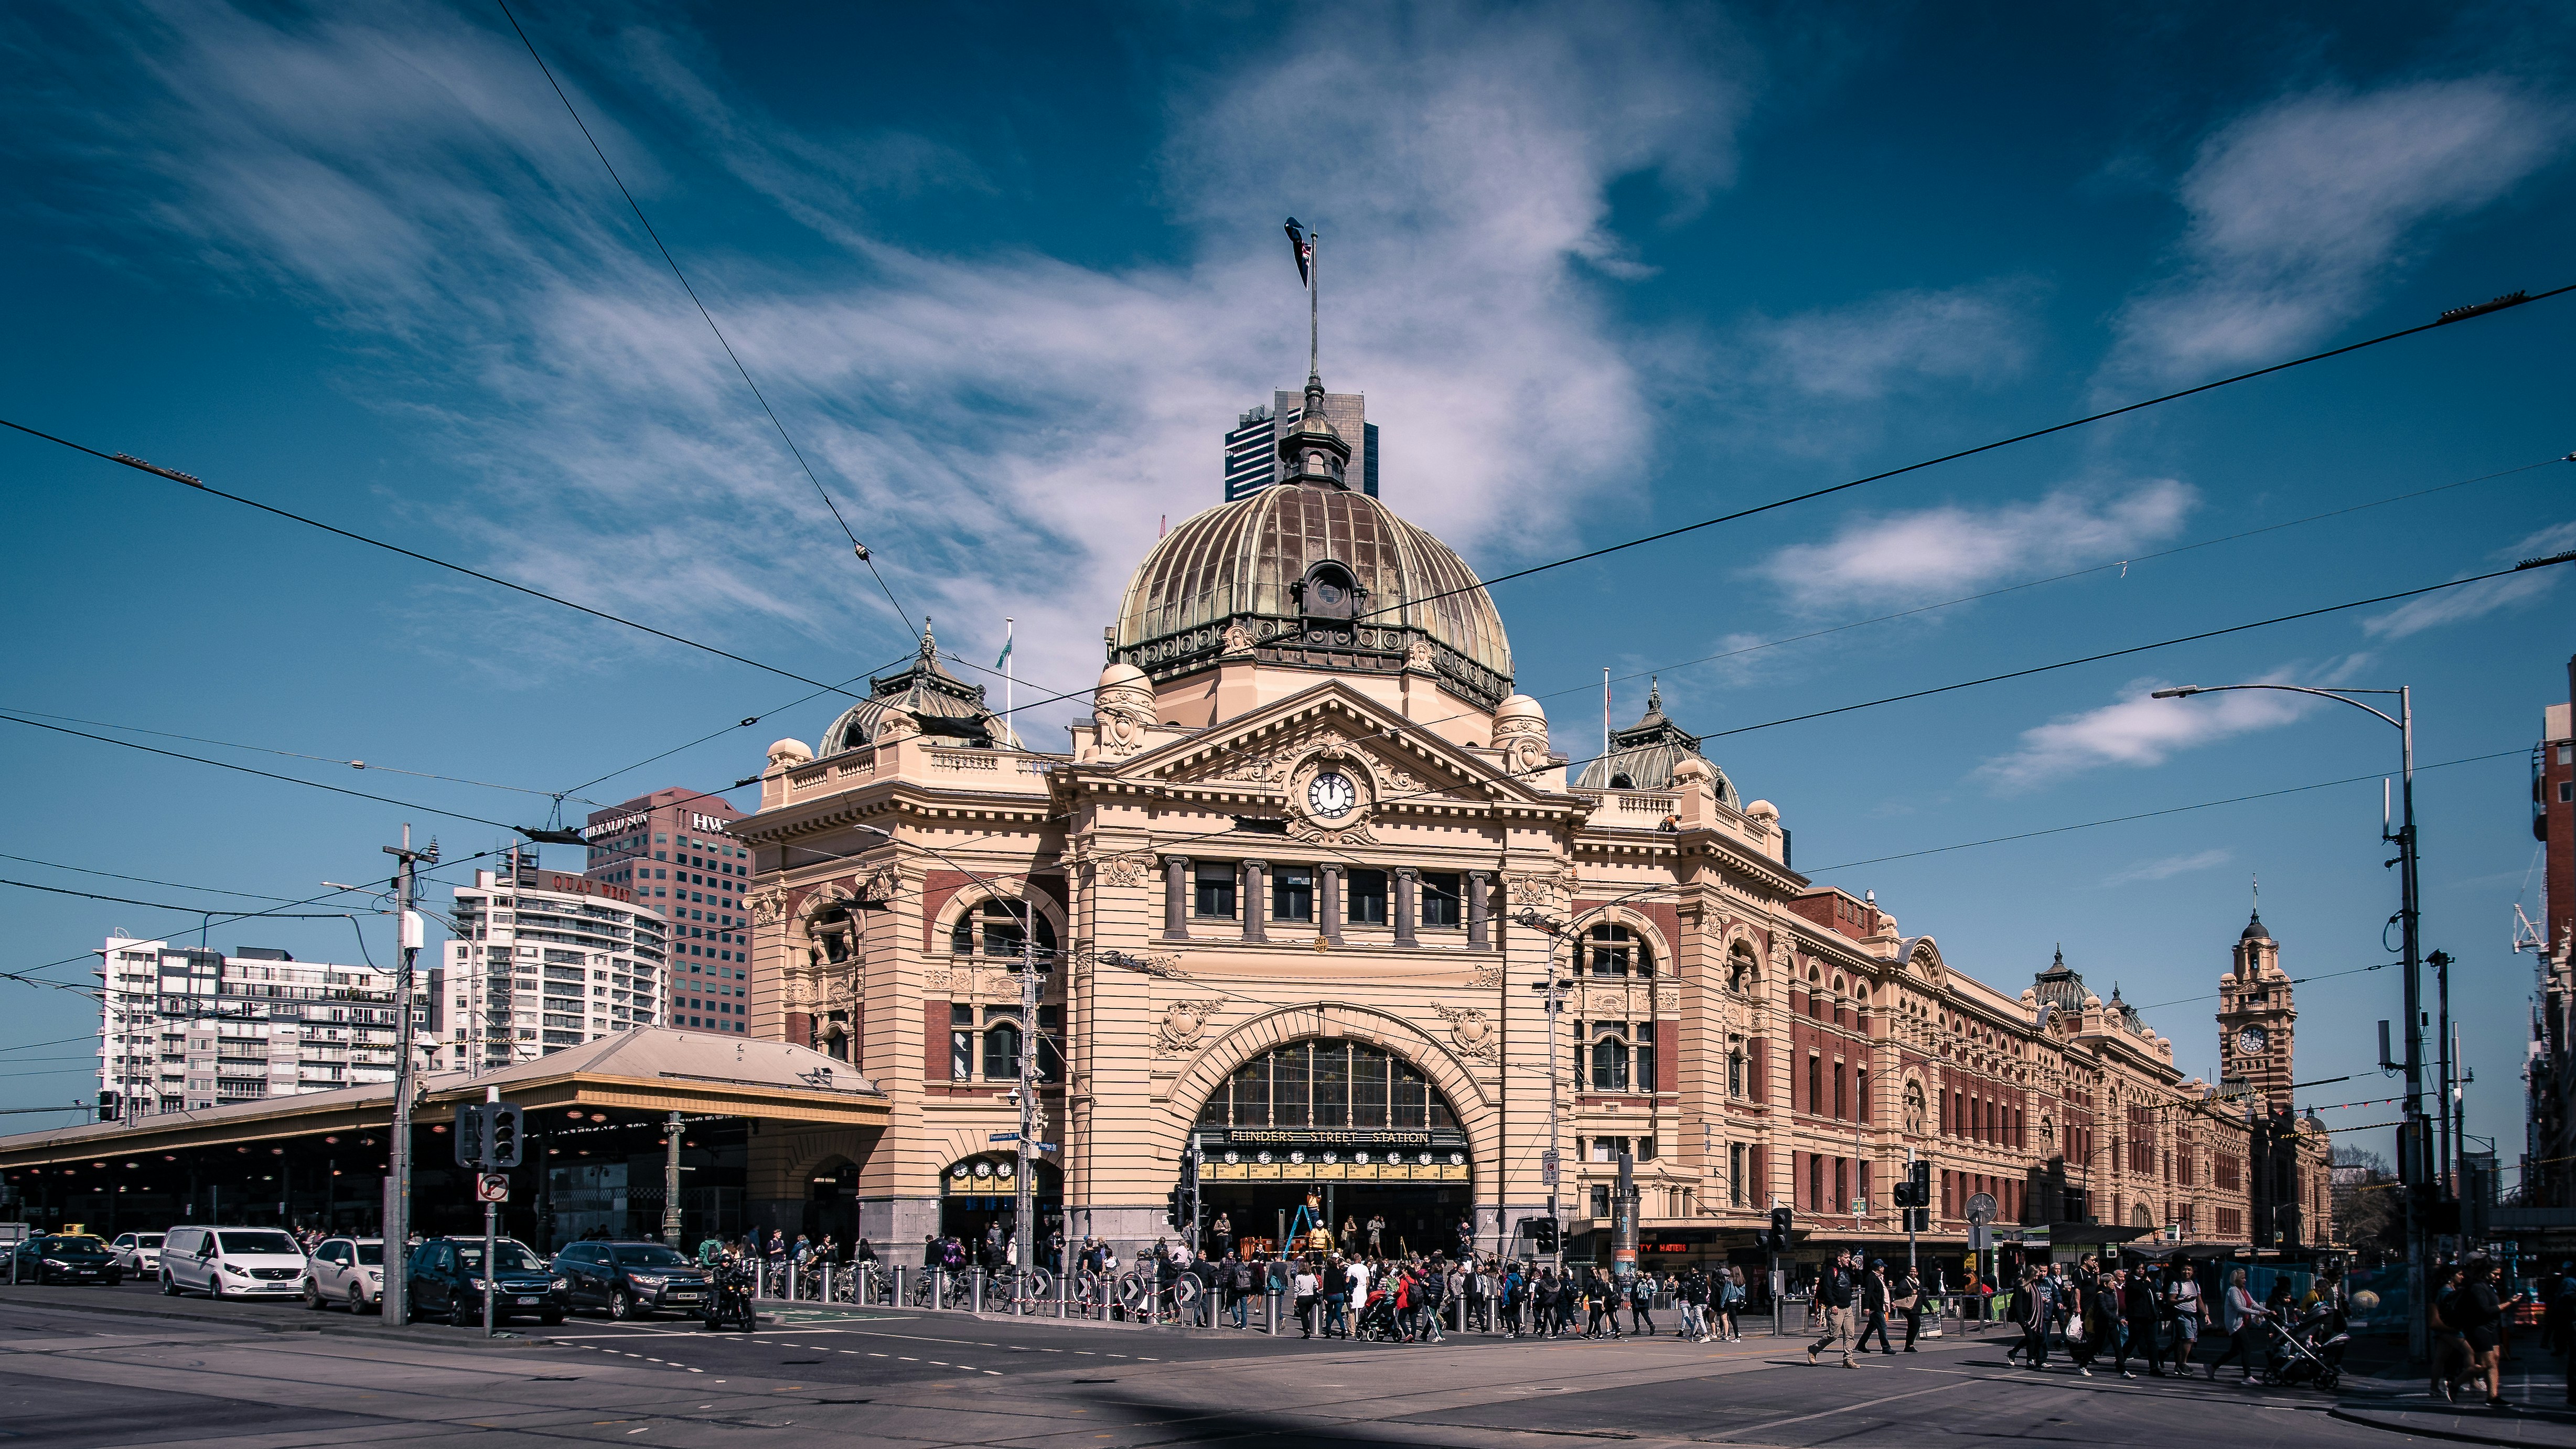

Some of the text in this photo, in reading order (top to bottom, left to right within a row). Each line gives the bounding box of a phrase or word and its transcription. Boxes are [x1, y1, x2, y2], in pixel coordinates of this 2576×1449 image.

[585, 812, 647, 838] HERALD SUN
[553, 875, 630, 903] QUAY WEST
[1231, 1131, 1429, 1143] FLINDERS STREET STATION
